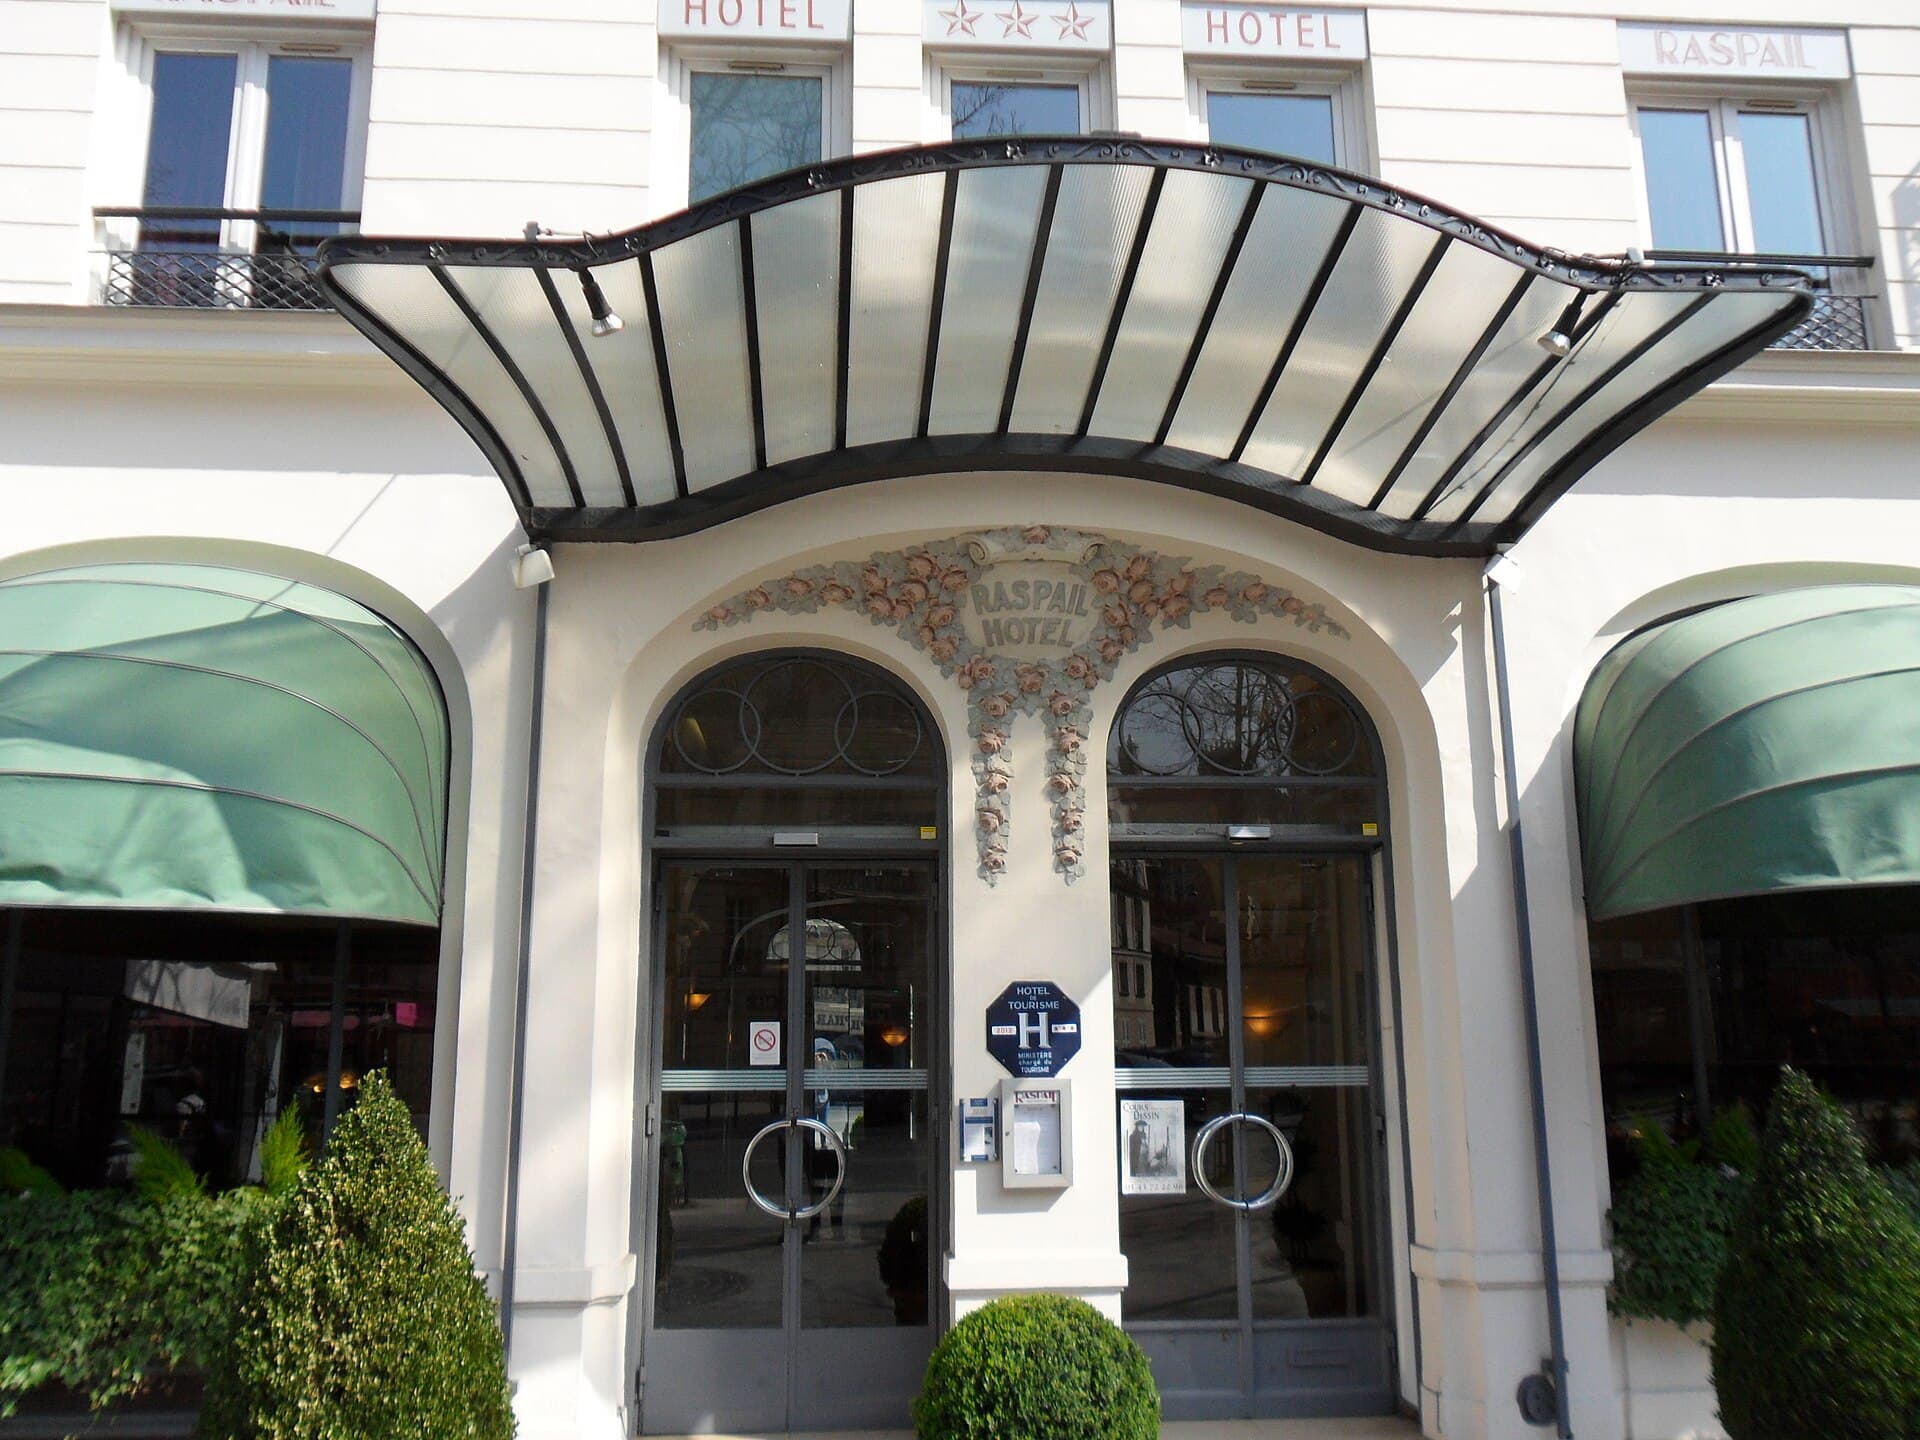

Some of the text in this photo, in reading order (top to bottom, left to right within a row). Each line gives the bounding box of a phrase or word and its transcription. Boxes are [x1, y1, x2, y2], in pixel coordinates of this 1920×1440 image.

[684, 0, 824, 29] HOTEL
[1206, 10, 1341, 48] HOTEL
[1653, 31, 1816, 70] RASPAIL
[970, 580, 1089, 617] RASPAIL
[982, 617, 1073, 648] HOTEL
[1008, 1001, 1060, 1009] TOURISME
[1016, 986, 1050, 995] HOTEL
[1018, 1012, 1051, 1049] H
